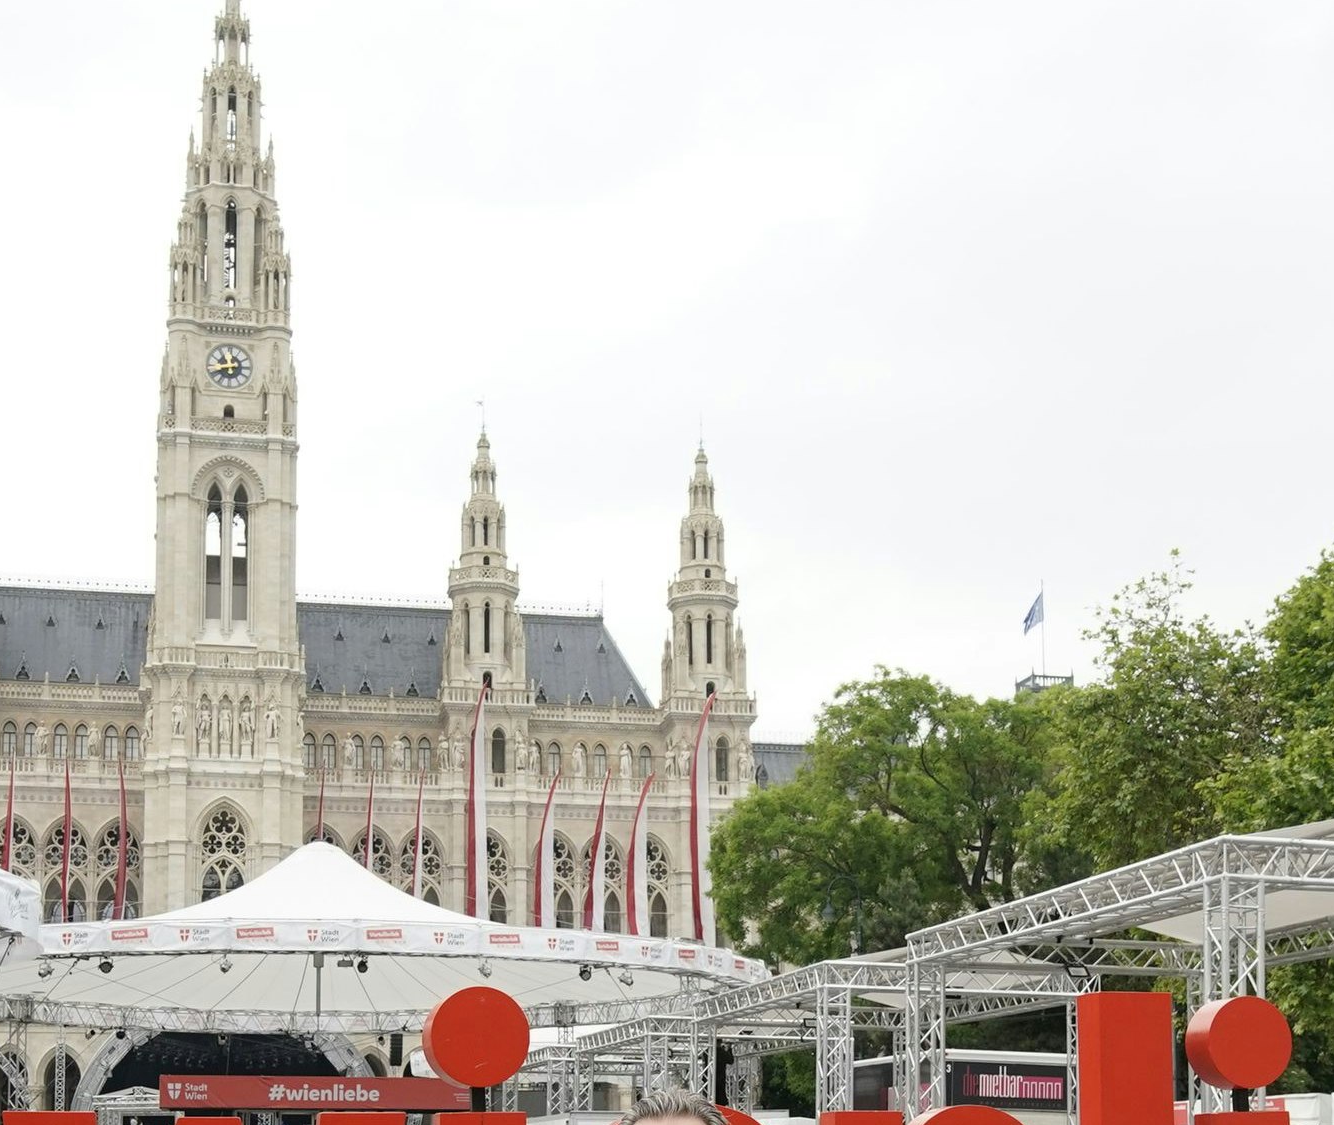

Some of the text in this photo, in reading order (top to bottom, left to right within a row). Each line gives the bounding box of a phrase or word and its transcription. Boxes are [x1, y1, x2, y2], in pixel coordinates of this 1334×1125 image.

[946, 1064, 952, 1073] 3
[184, 1082, 208, 1092] Stadt
[184, 1092, 208, 1101] Wien
[268, 1084, 380, 1102] #wienliebe
